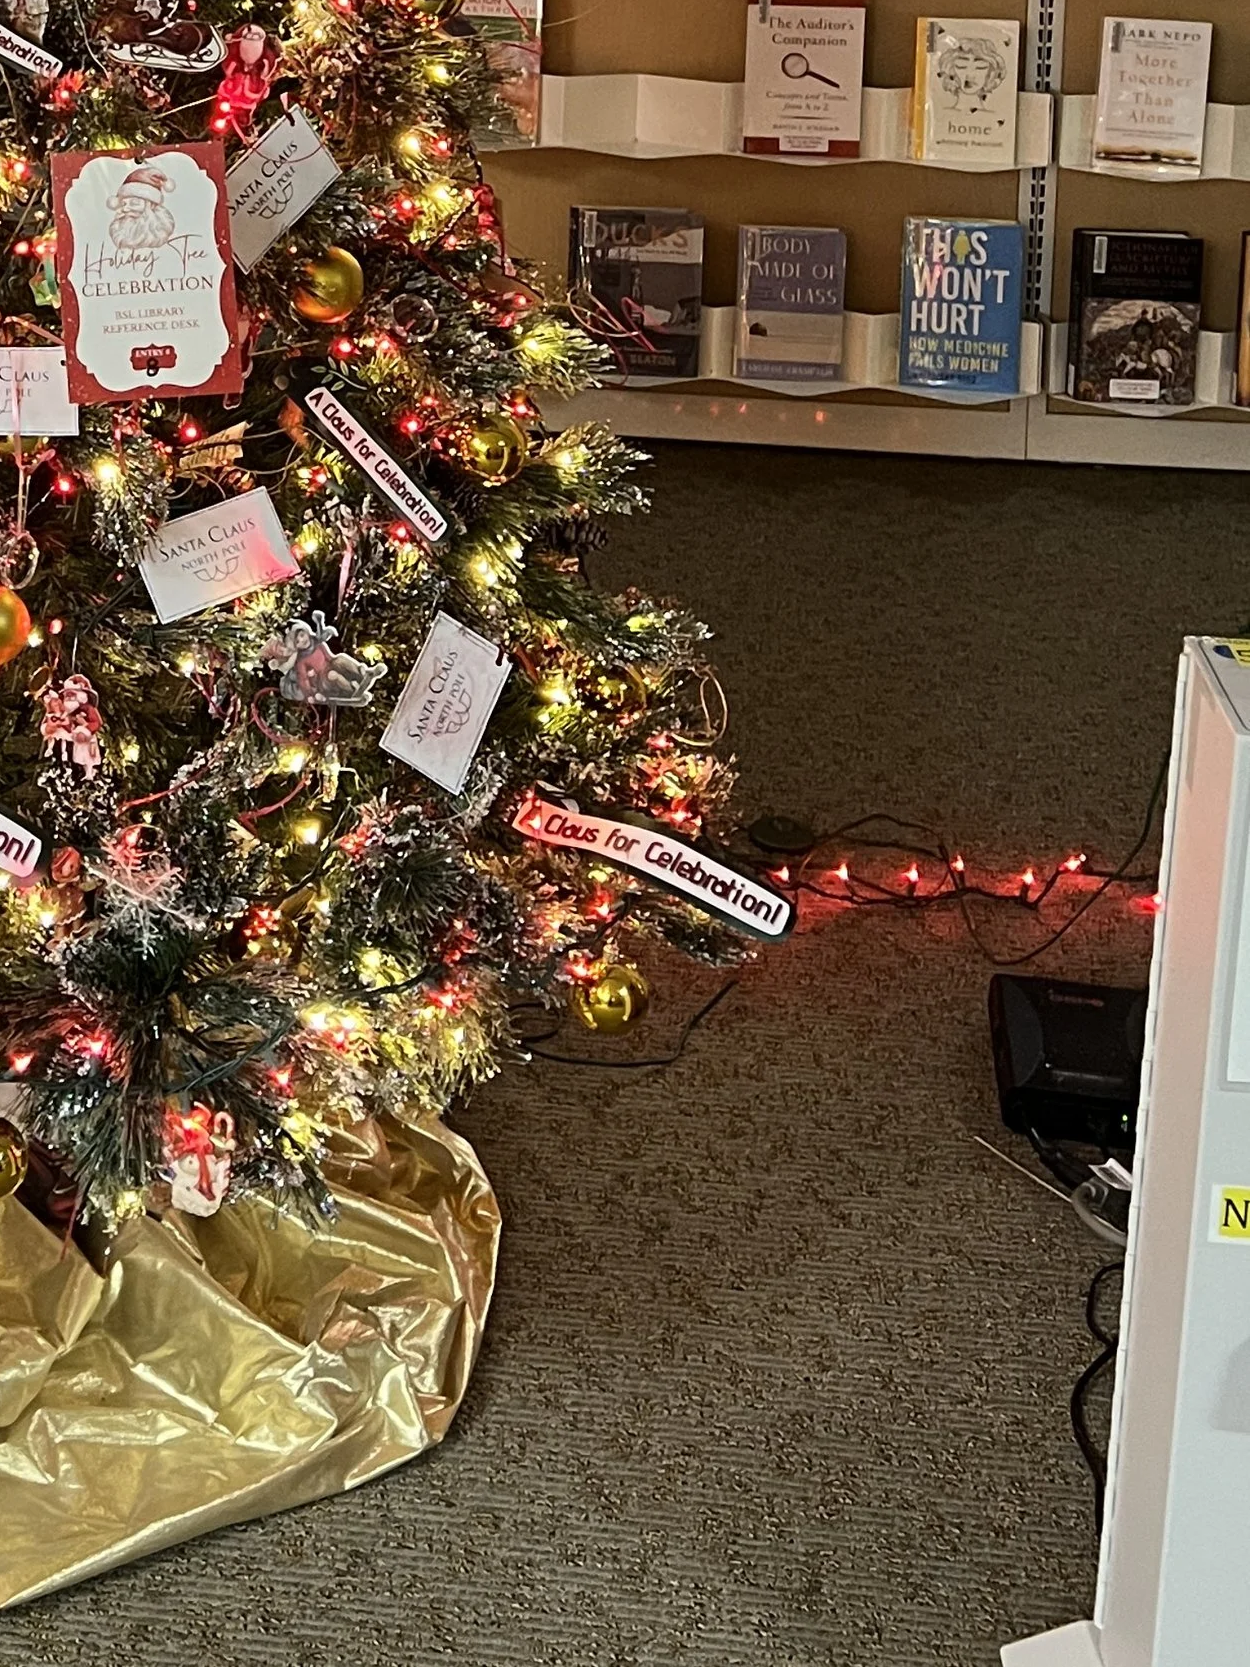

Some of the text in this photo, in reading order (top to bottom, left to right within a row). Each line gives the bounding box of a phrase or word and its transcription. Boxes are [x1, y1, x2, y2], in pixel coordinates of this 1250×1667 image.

[770, 16, 855, 31] The Auditor's
[772, 33, 848, 48] Companion
[1136, 54, 1178, 68] More
[1119, 71, 1193, 86] Together
[1133, 92, 1174, 106] Than
[1129, 110, 1175, 124] Alone
[948, 121, 992, 135] home
[227, 140, 298, 216] SANTA CLAUS
[247, 188, 277, 217] NORTH
[762, 237, 813, 254] BODY
[84, 234, 208, 284] Holiday Tree
[755, 261, 834, 280] MADE OF
[82, 275, 214, 298] CELEBRATION
[913, 264, 1010, 304] WON'T
[781, 287, 837, 305] GLASS
[115, 306, 186, 320] BSL LIBRARY
[910, 300, 985, 336] HURT
[102, 319, 200, 334] REFERENCE DESK
[135, 349, 163, 357] ENTRY
[909, 336, 1009, 358] HOW MEDICINE
[949, 357, 999, 373] WOMEN
[309, 391, 444, 534] A Claus for Celebration!
[160, 517, 256, 563] SANTA CLAUS
[181, 541, 247, 571] NORTH POLE
[408, 651, 458, 744] SANTA CLAUS
[433, 701, 454, 736] NORTH
[544, 814, 783, 925] Claus for Celebration!
